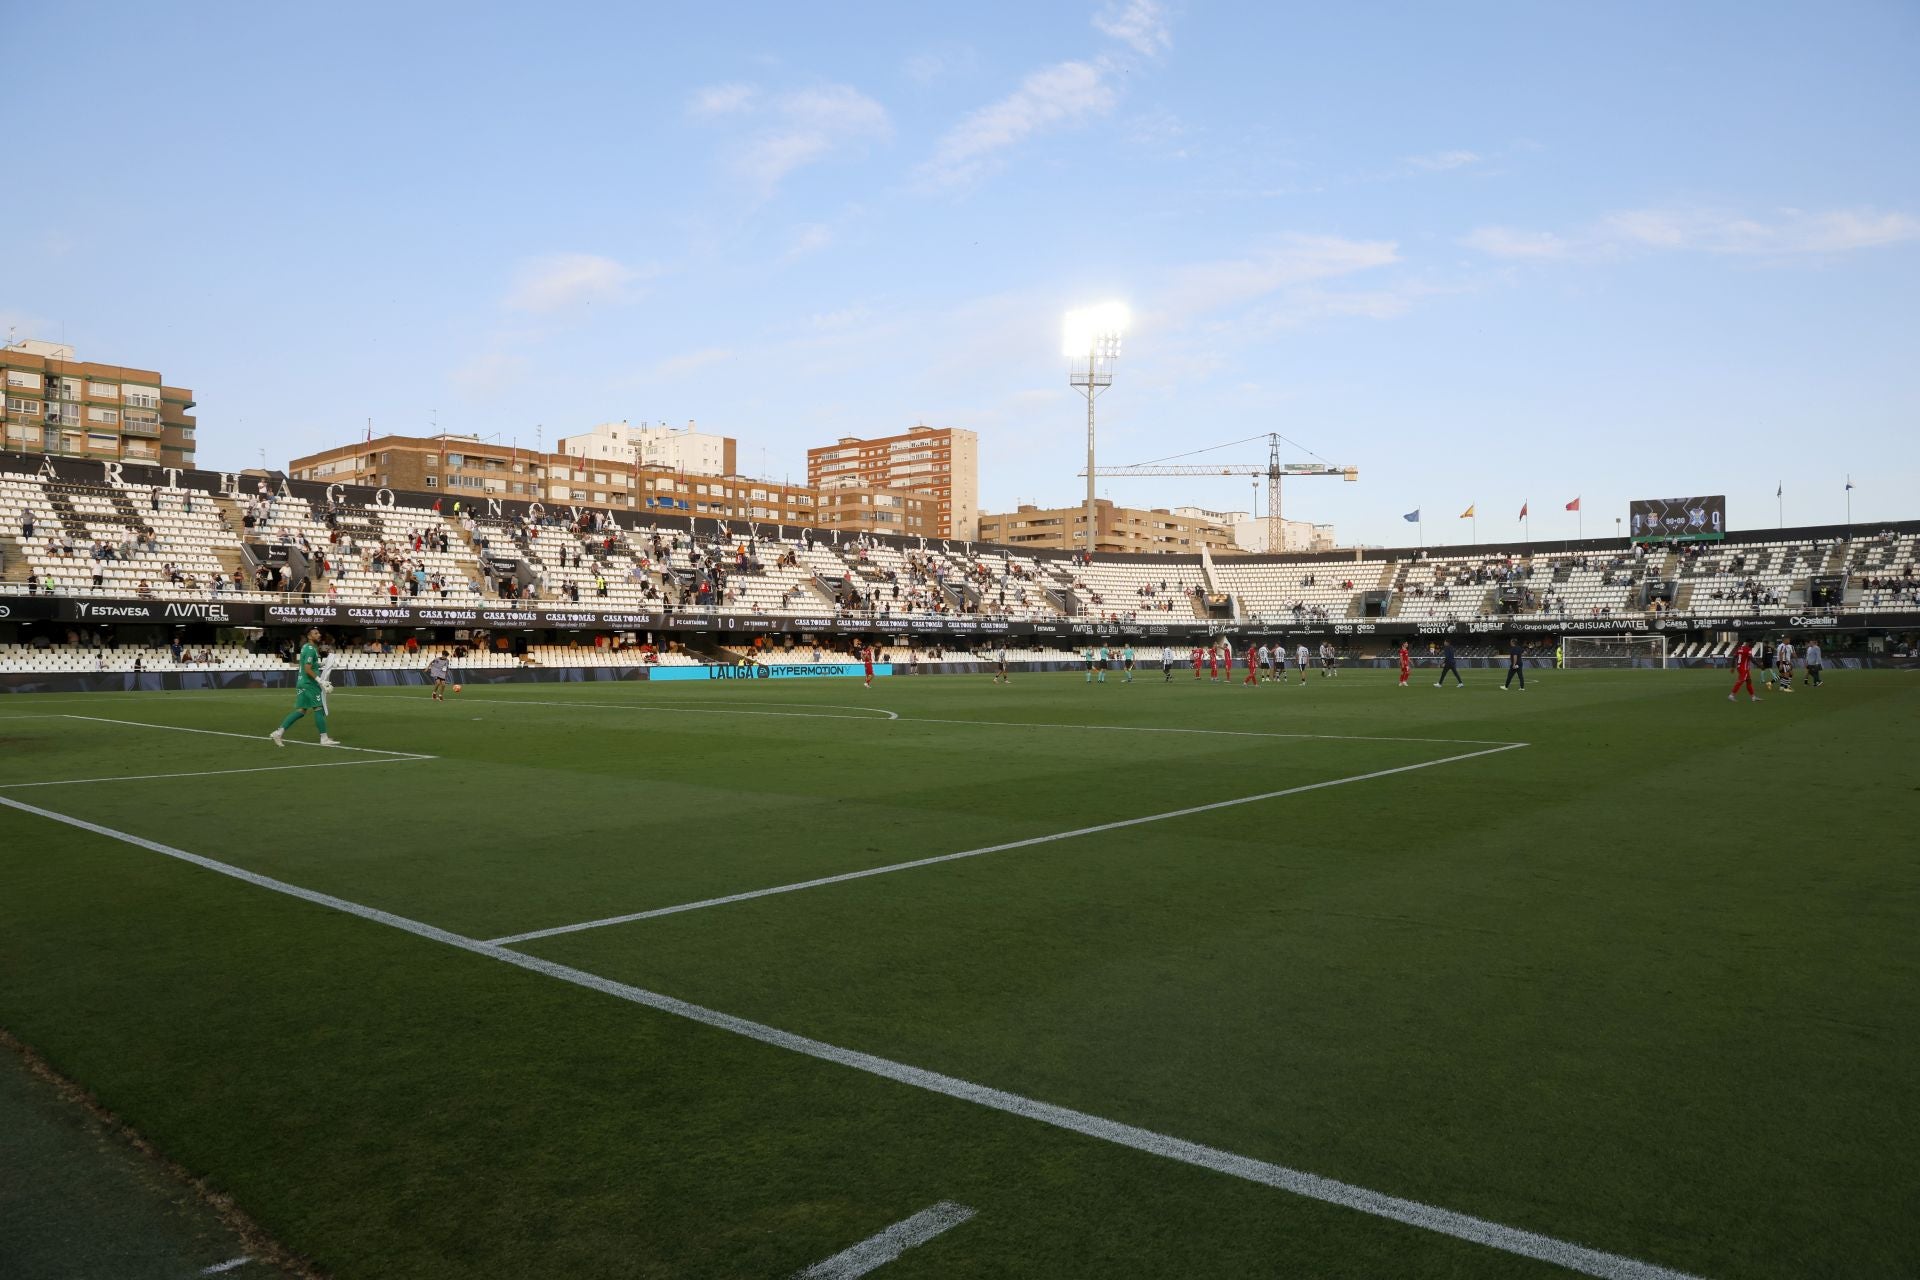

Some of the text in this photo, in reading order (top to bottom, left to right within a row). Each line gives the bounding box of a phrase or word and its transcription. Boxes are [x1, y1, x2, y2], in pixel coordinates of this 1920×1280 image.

[1711, 511, 1720, 525] 0
[91, 606, 150, 616] ESTAVESA
[164, 603, 229, 617] AVATEL
[269, 606, 337, 616] CASA TOMÁS
[348, 608, 410, 617] CASA TOMÁS
[419, 610, 476, 619] CASA TOMÁS
[506, 611, 537, 620] TOMÁS
[545, 613, 596, 622] CASA TOMÁS
[602, 614, 650, 622] CASA TOMÁS
[1800, 616, 1838, 625] Castellini
[728, 618, 735, 629] 0
[1612, 620, 1648, 629] AVATEL
[1334, 624, 1352, 634] gesa
[1357, 624, 1375, 634] gesa
[709, 664, 754, 679] LALIGA
[771, 666, 844, 676] HYPERMOTION
